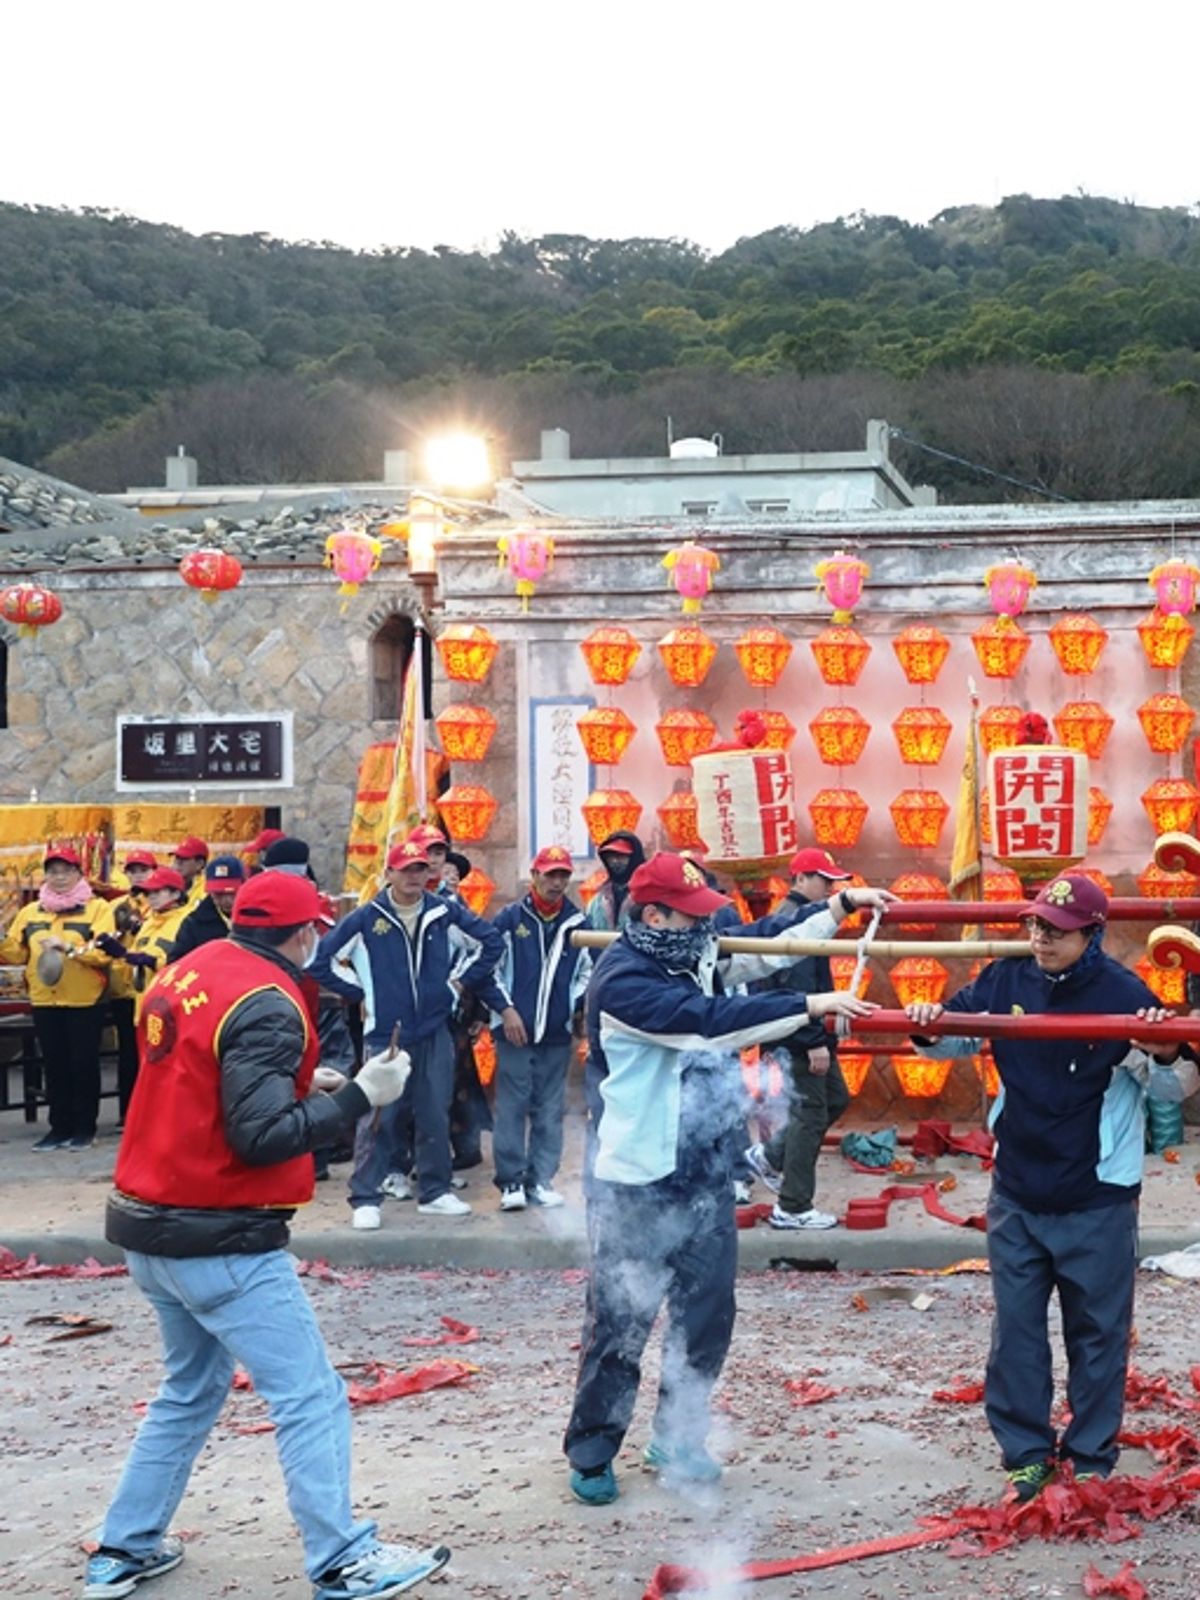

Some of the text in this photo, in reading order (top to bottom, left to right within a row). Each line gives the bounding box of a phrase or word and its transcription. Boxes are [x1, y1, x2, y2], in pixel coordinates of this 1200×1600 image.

[144, 730, 261, 756] 坂里大宅
[993, 755, 1075, 858] 開閩
